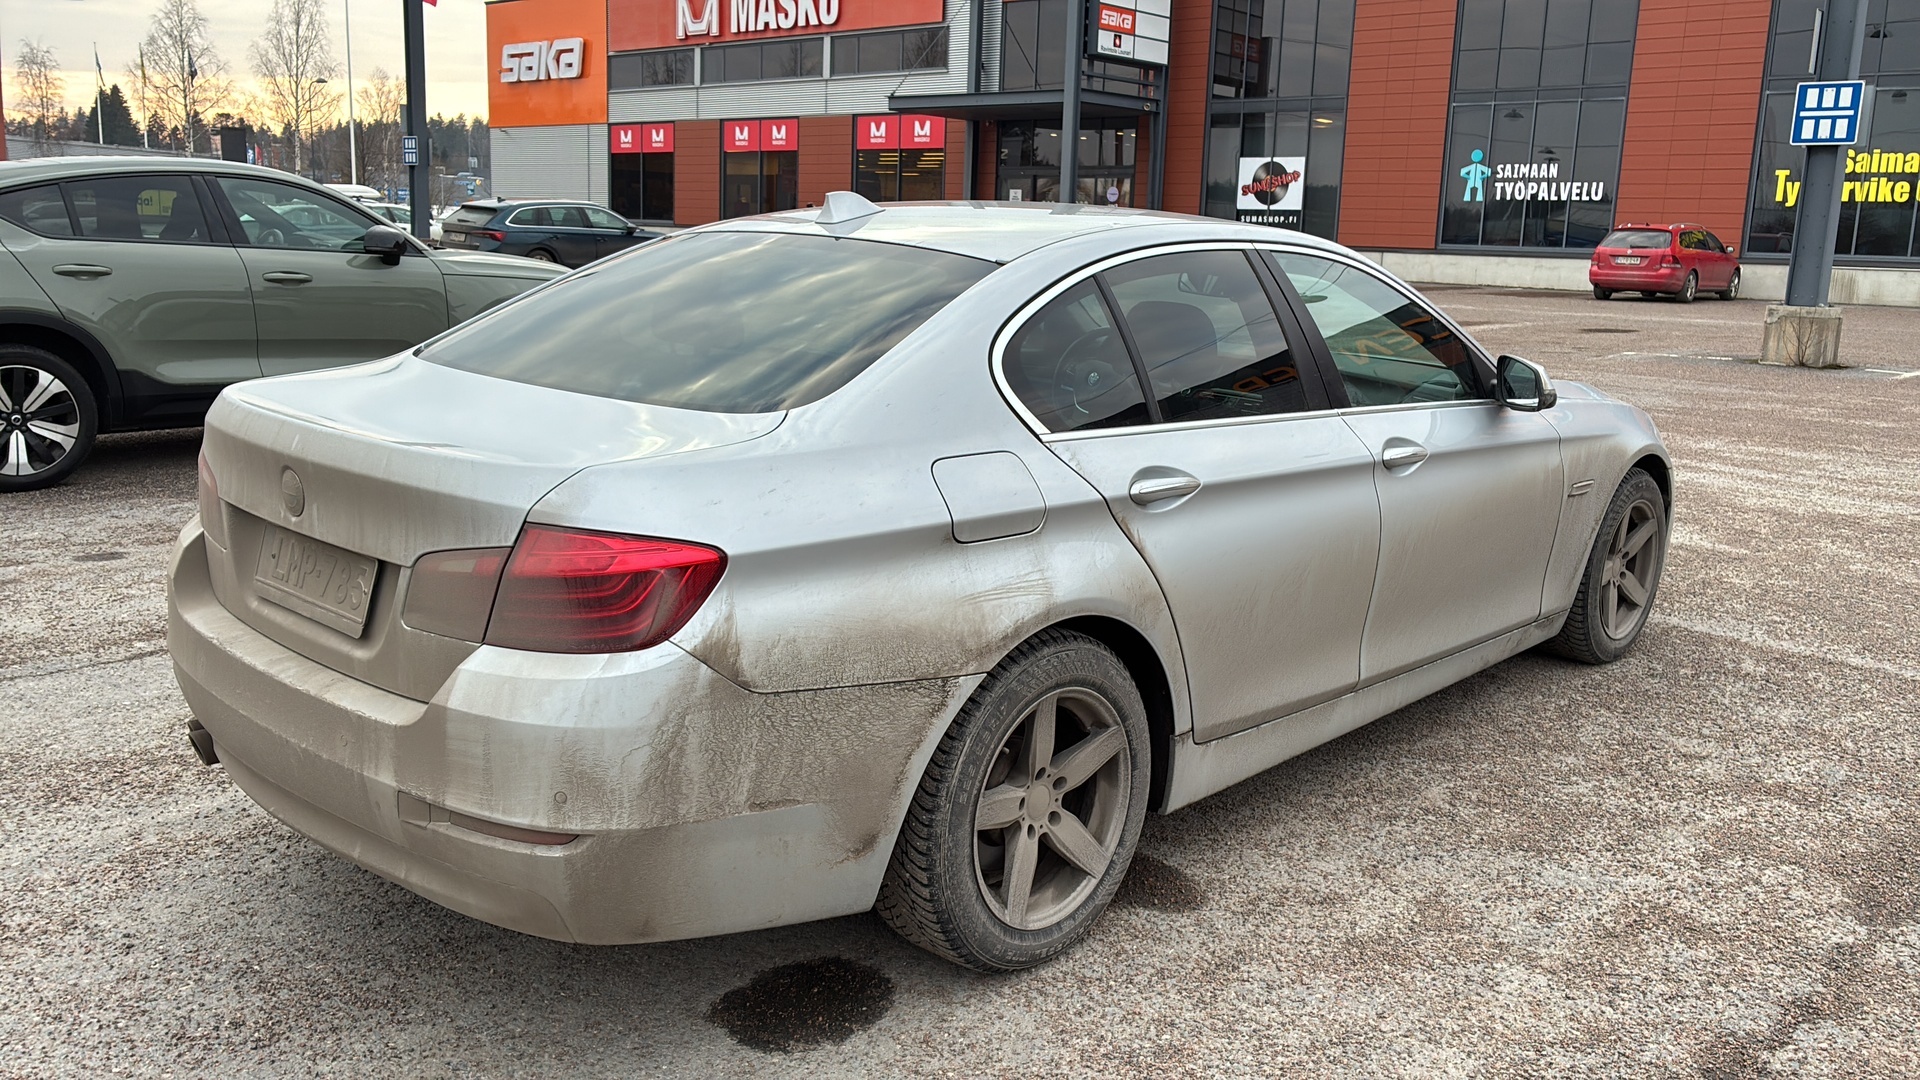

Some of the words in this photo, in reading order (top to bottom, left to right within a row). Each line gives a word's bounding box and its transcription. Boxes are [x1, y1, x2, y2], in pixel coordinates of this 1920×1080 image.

[731, 0, 839, 33] MASKU
[1496, 163, 1559, 179] SAIMAAN
[1494, 180, 1604, 202] TYÖPALVELU
[1775, 169, 1911, 207] Tyrvike
[1241, 215, 1297, 223] SUMASHOP.FI
